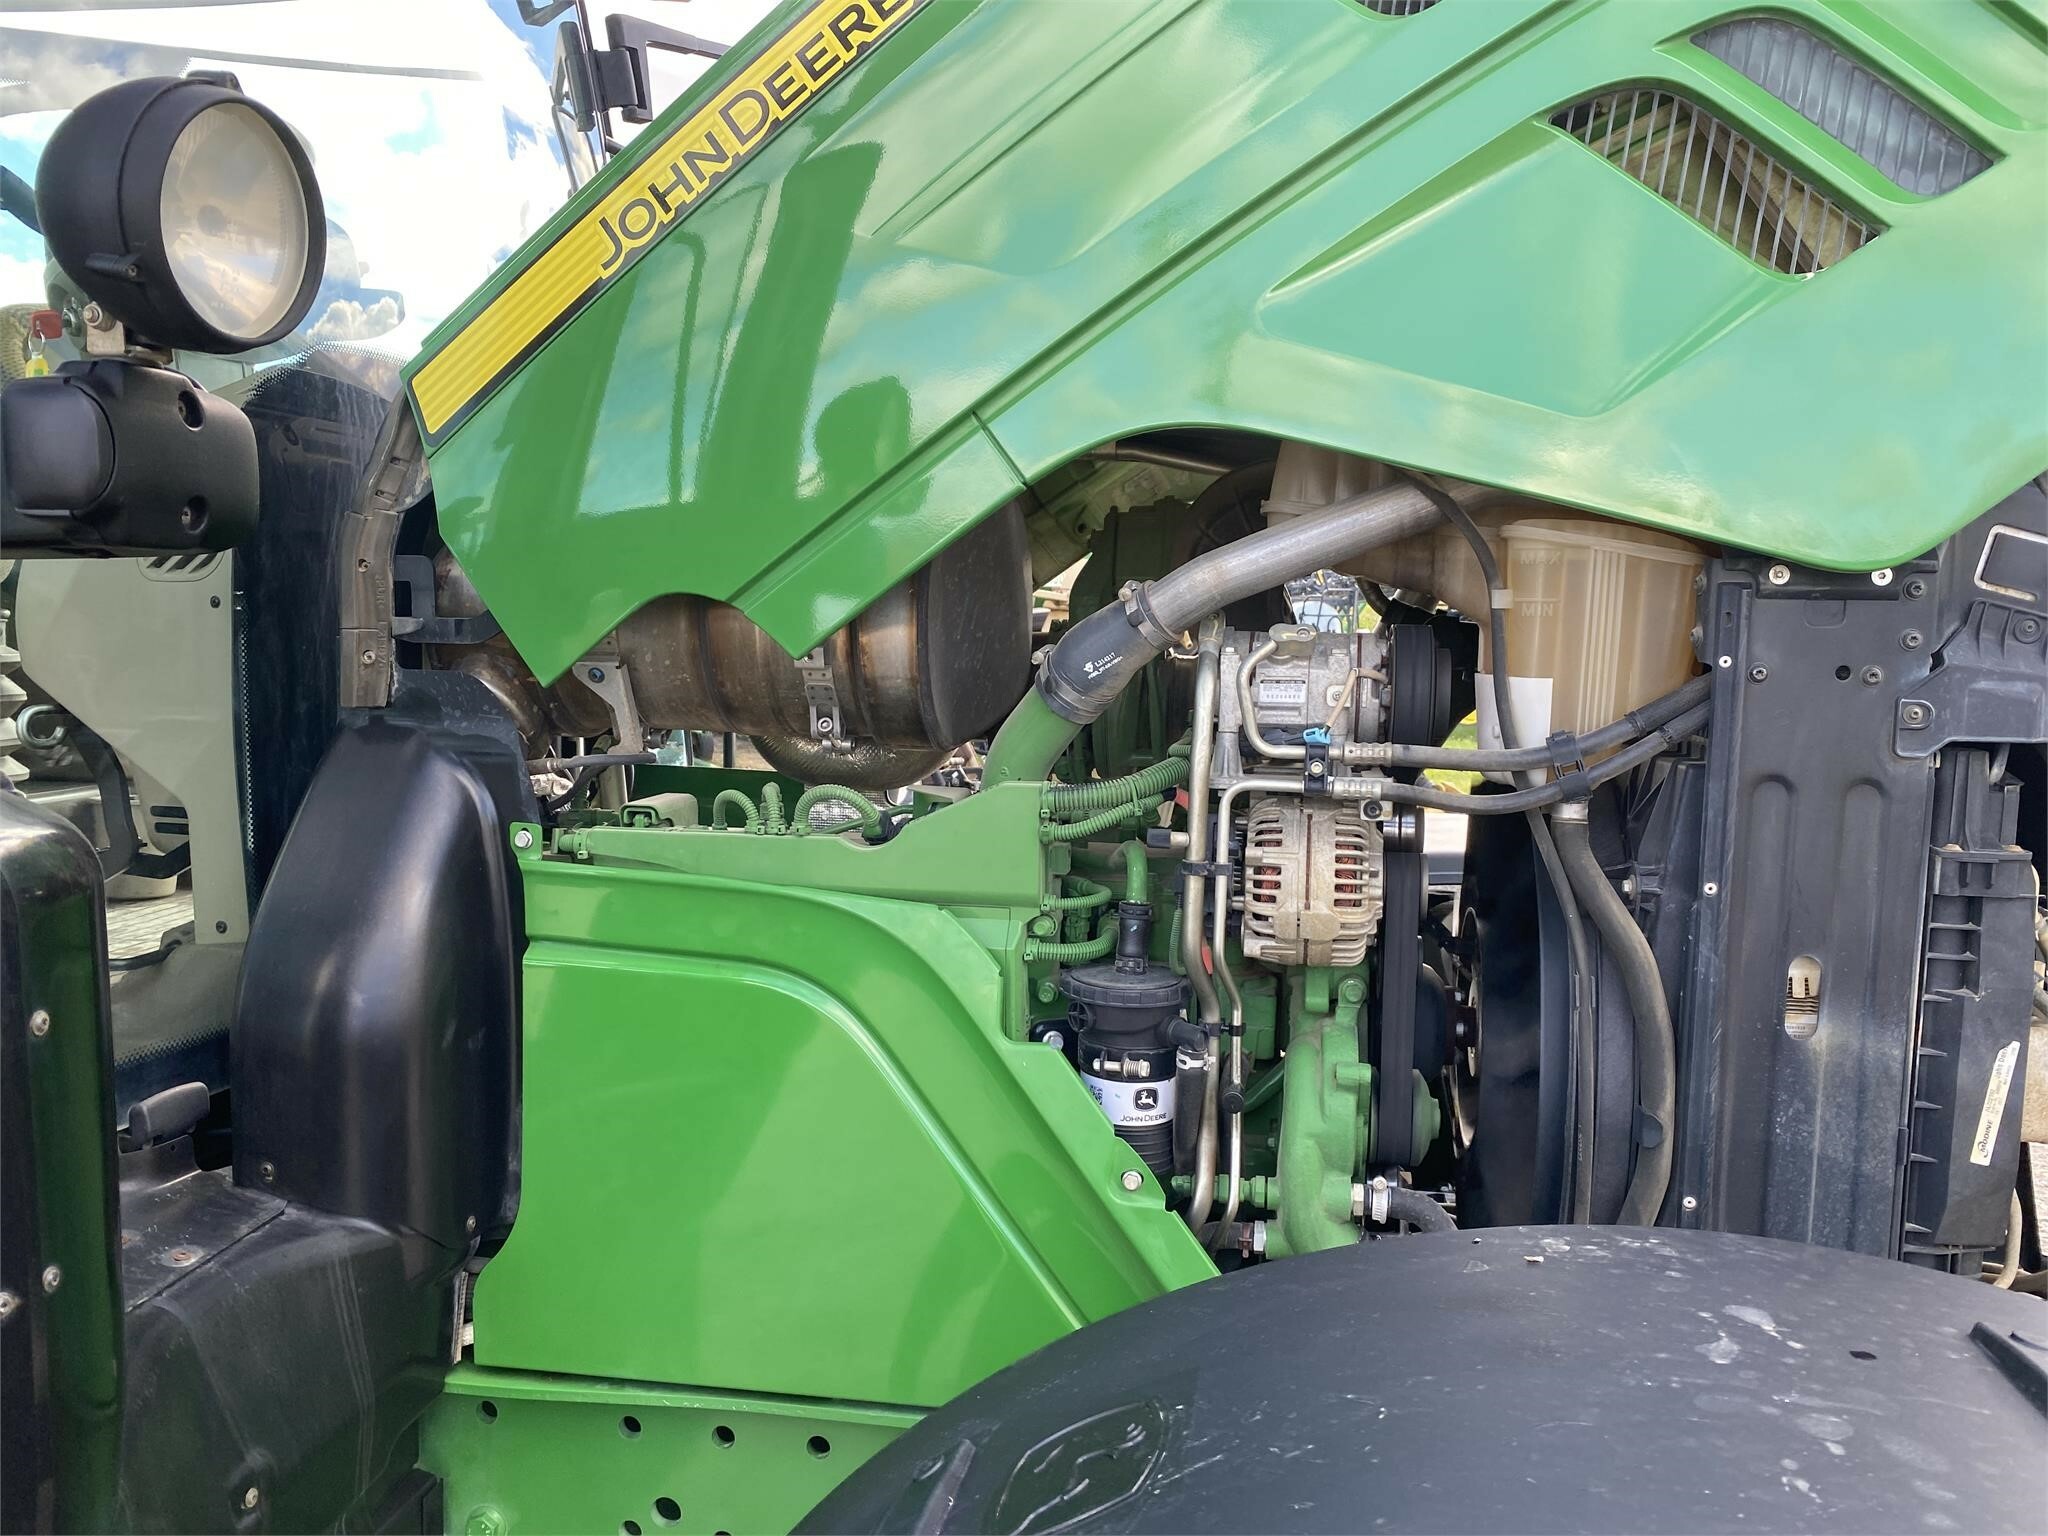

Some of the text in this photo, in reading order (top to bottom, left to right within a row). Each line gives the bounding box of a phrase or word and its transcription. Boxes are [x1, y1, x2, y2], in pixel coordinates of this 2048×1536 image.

[599, 131, 730, 270] JOHN
[1520, 551, 1561, 565] MAX
[1521, 603, 1554, 617] MIN
[1121, 1112, 1168, 1123] JOHN DEERE
[1979, 1120, 1993, 1154] MODINE
